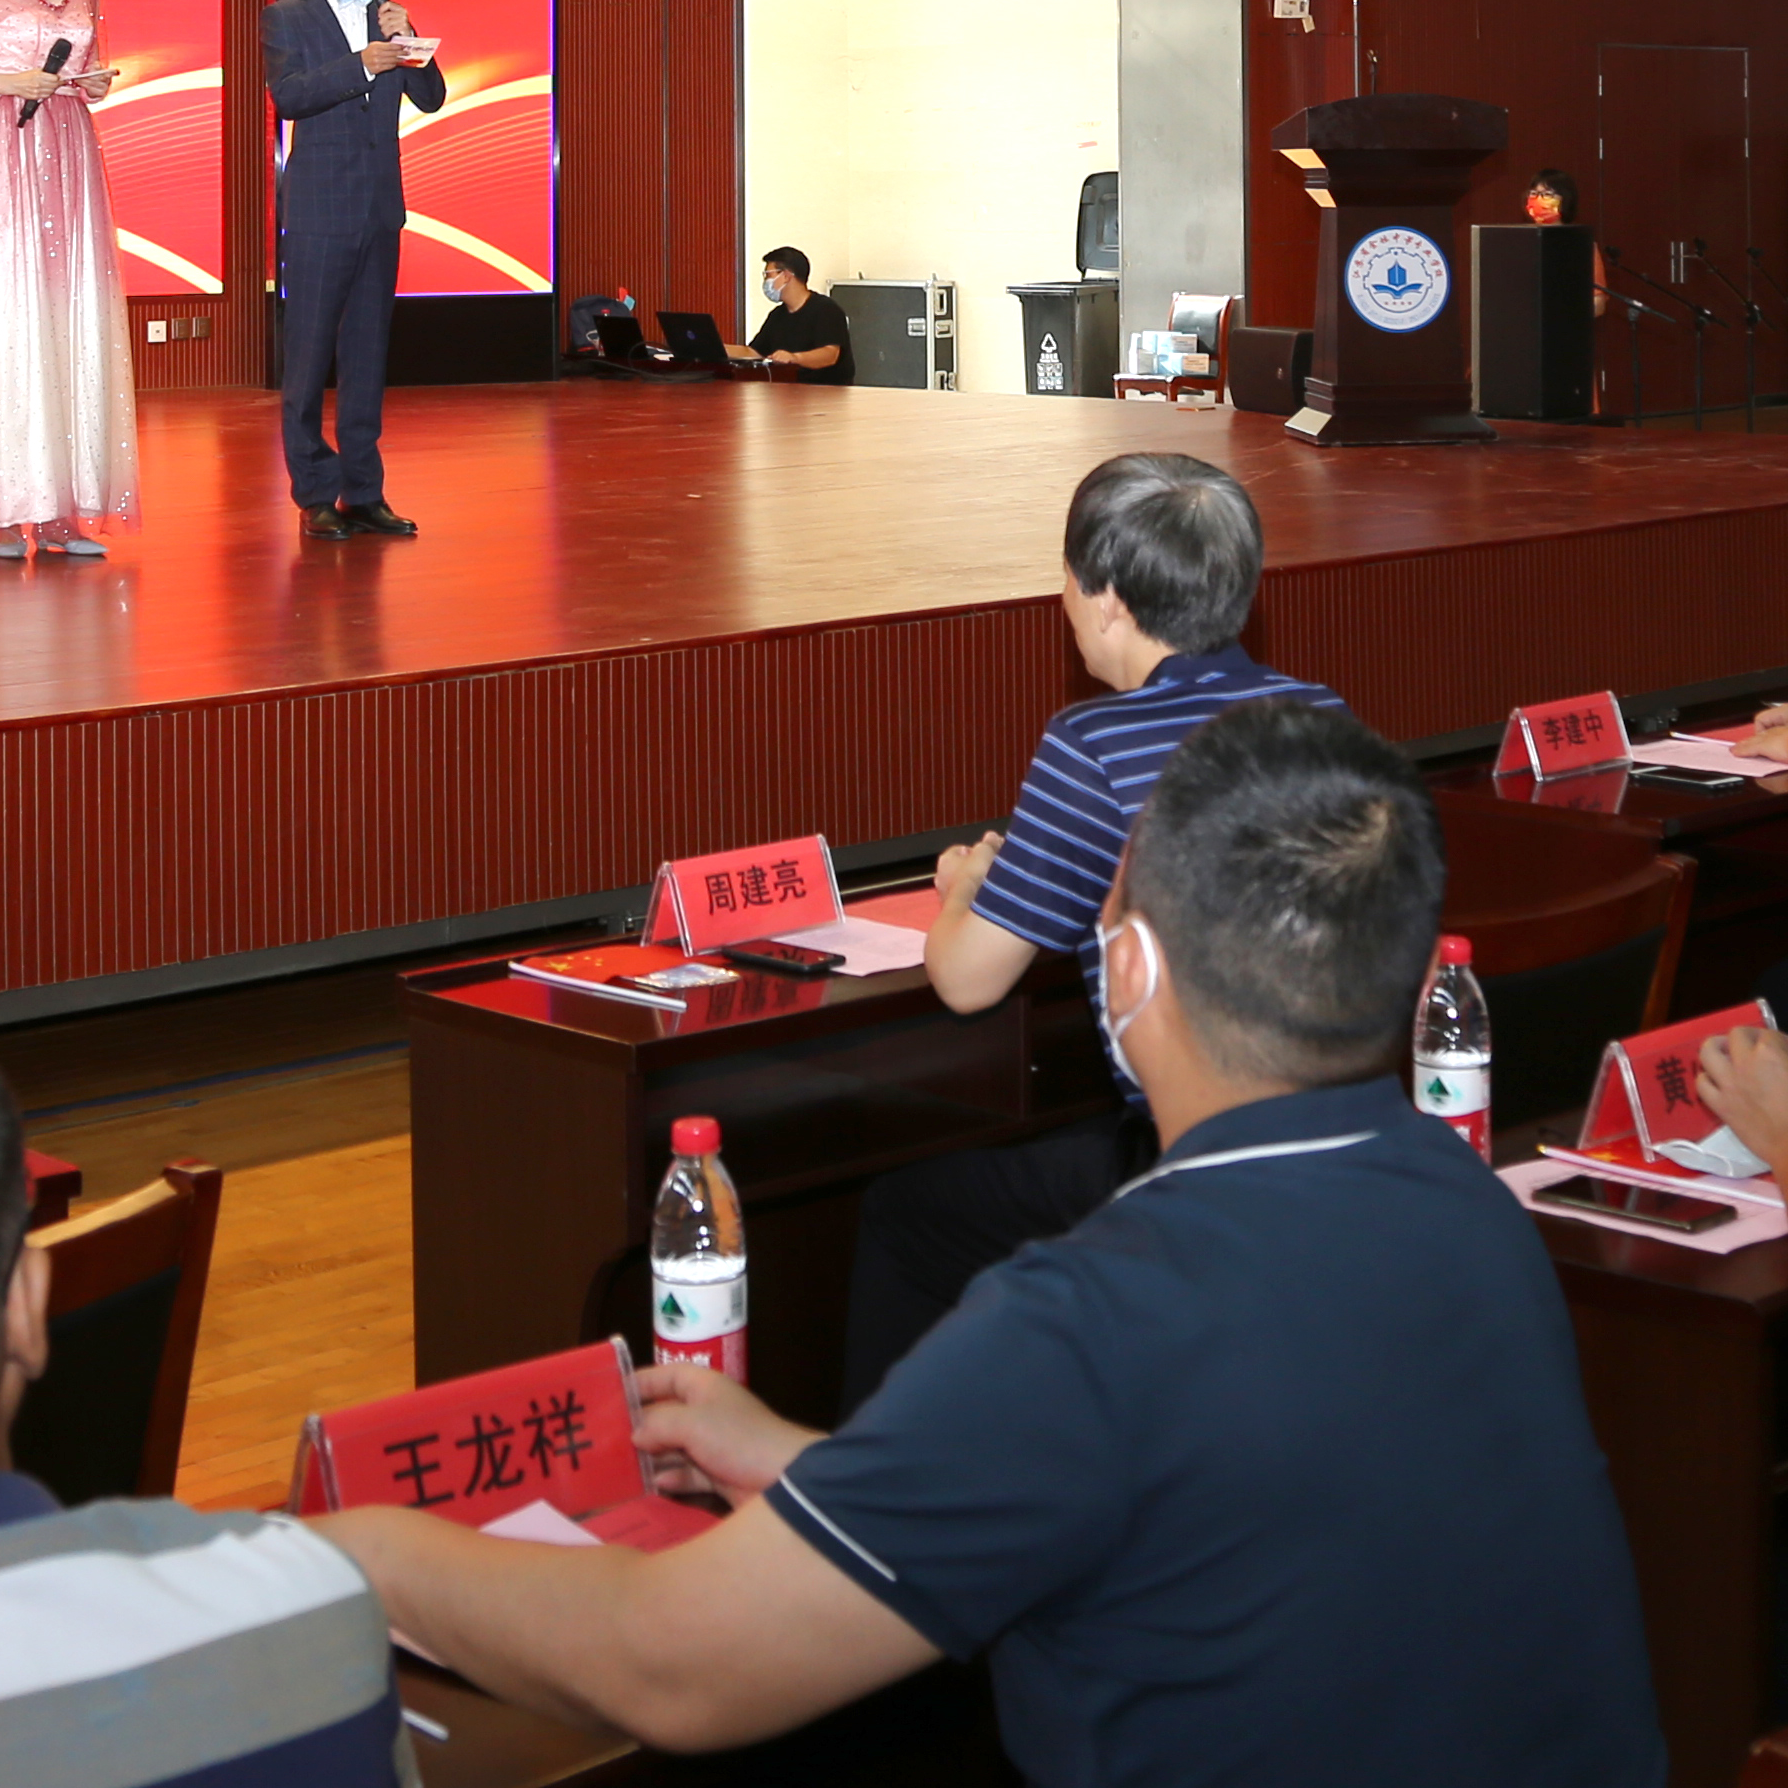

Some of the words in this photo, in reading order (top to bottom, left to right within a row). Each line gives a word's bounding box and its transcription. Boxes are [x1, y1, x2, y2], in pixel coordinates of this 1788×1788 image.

[703, 858, 808, 916] 周建亮
[383, 1389, 594, 1510] 王龙祥
